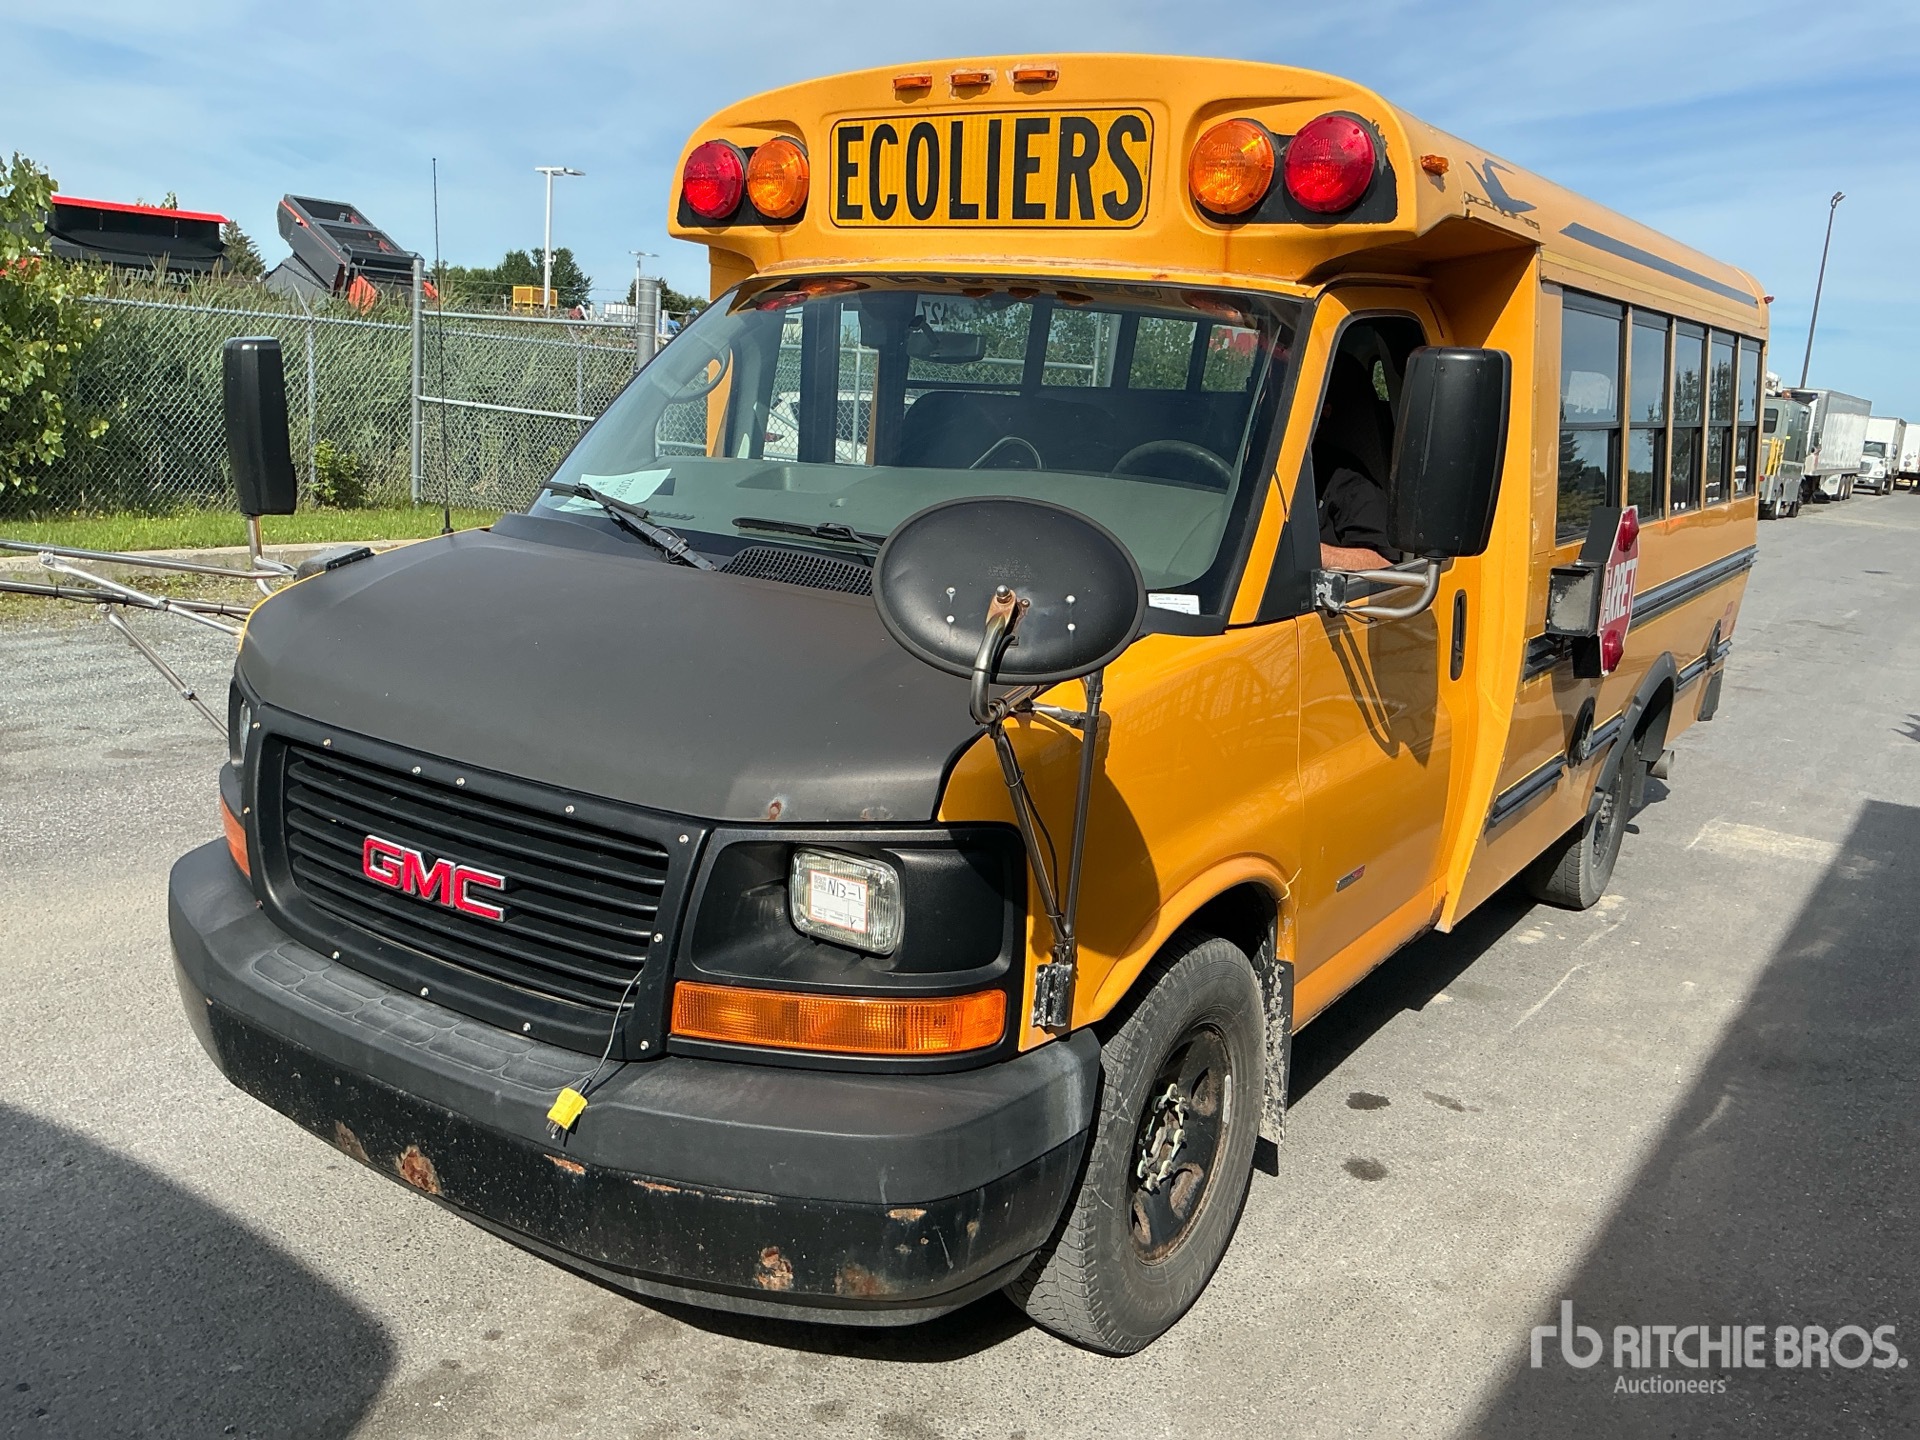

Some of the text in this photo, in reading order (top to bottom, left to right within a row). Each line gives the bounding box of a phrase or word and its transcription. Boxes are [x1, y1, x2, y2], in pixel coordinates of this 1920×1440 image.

[837, 115, 1147, 221] ECOLIERS
[124, 267, 190, 285] FINAY
[363, 834, 506, 923] GMC
